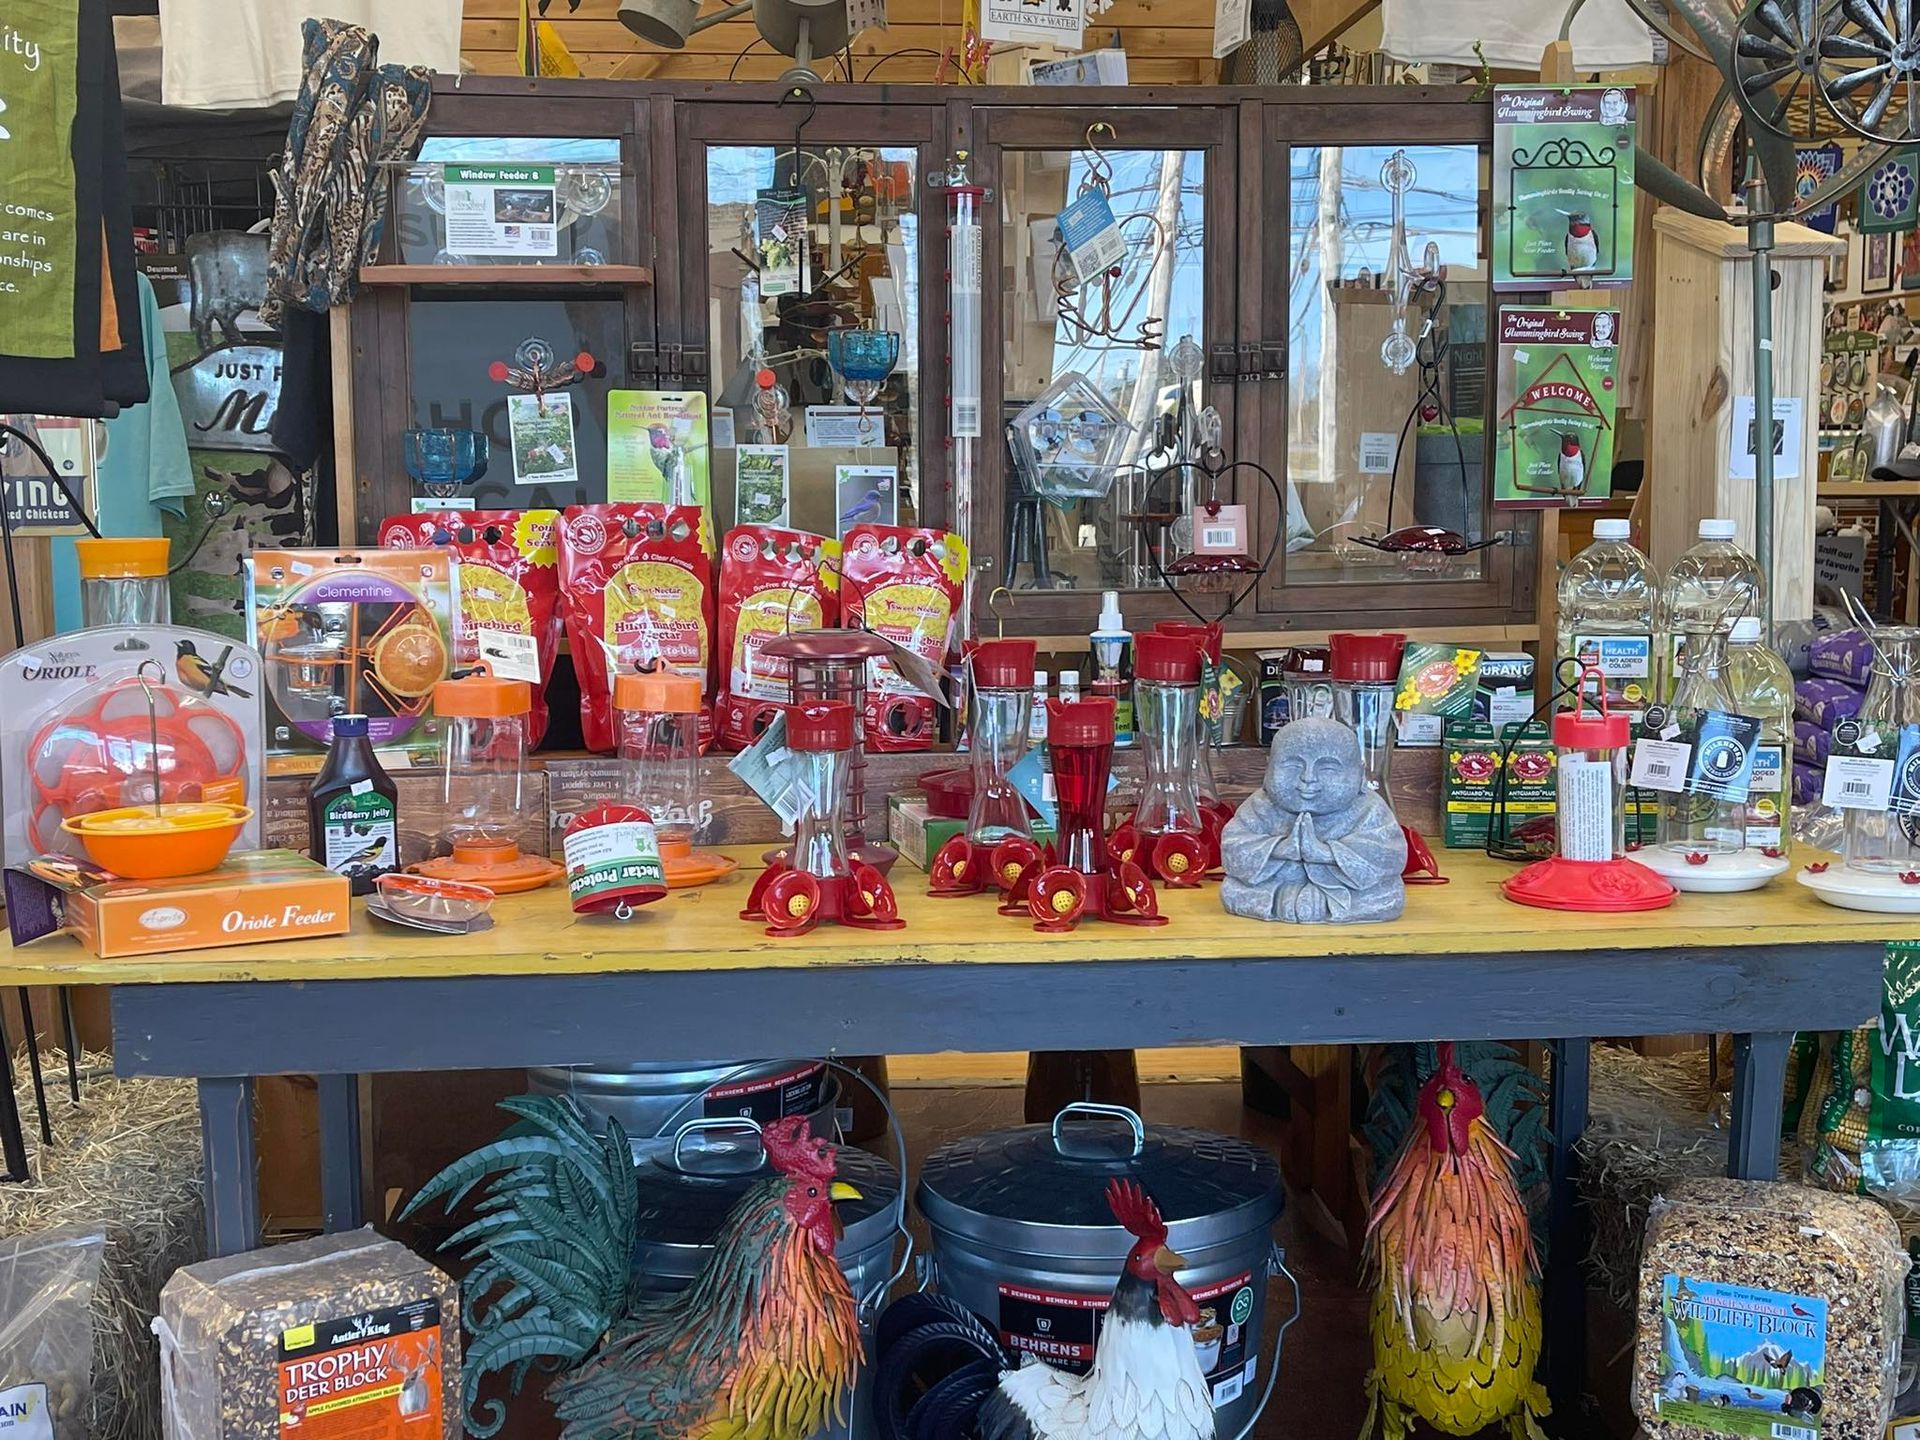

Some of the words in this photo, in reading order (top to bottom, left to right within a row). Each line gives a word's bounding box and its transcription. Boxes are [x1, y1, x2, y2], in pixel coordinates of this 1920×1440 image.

[990, 11, 1021, 22] EARTH
[1022, 14, 1039, 24] SKY
[1046, 17, 1077, 29] WATER
[1511, 96, 1545, 108] Original
[1562, 105, 1595, 120] Swing
[460, 169, 495, 180] Window
[499, 170, 529, 180] Feeder
[5, 204, 55, 221] comes
[2, 231, 29, 243] are
[33, 231, 46, 246] in
[1516, 316, 1545, 329] Original
[1504, 328, 1560, 341] Hummingbird
[1559, 327, 1587, 341] Swing
[215, 363, 263, 380] JUST
[1531, 385, 1591, 408] WELCOME
[1818, 545, 1837, 556] Sniff
[1837, 549, 1853, 561] out
[1826, 559, 1860, 574] favorite
[1820, 570, 1838, 581] toy!
[316, 585, 393, 598] Clementine
[1605, 647, 1640, 655] HEALTH
[23, 664, 98, 681] ORIOLE
[1480, 664, 1532, 677] URANT
[561, 780, 590, 790] support
[592, 781, 612, 790] Liver
[329, 810, 370, 821] BirdBerry
[372, 808, 390, 818] Jelly
[622, 864, 660, 880] Nectar
[222, 910, 276, 934] Oriole
[281, 905, 335, 928] Feeder
[1011, 1290, 1041, 1301] BEHRENS
[1045, 1297, 1078, 1307] BEHRENS
[1192, 1288, 1219, 1301] BEHRENS
[1716, 1289, 1732, 1297] Pine
[1733, 1291, 1749, 1299] Tree
[1746, 1302, 1787, 1316] CRUNCH
[1671, 1300, 1754, 1328] WILDLIFE
[1758, 1315, 1817, 1338] BLOCK
[331, 1331, 361, 1345] Antler
[367, 1322, 391, 1336] King
[1010, 1335, 1082, 1357] BEHRENS
[285, 1343, 389, 1387] TROPHY
[286, 1380, 330, 1404] DEER
[334, 1365, 389, 1392] BLOCK
[308, 1405, 324, 1414] APPLE
